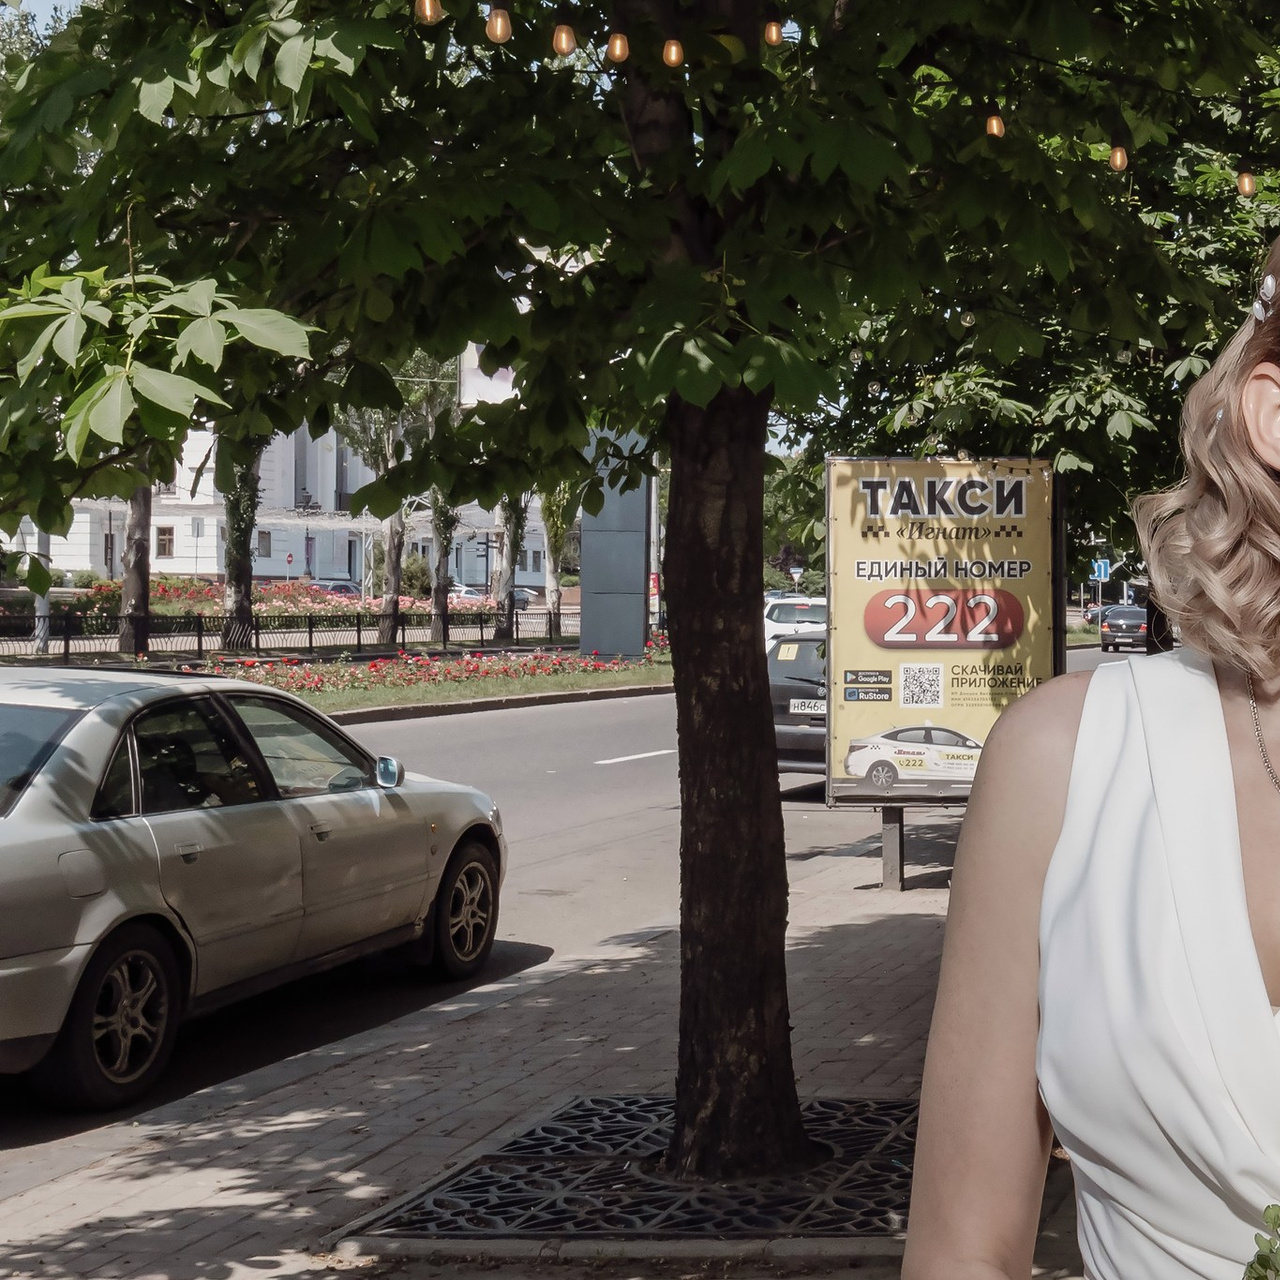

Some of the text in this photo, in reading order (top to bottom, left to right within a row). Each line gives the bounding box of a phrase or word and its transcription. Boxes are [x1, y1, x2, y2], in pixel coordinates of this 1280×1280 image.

[860, 478, 1025, 517] ТАКСИ
[896, 521, 992, 541] «Игнат»
[856, 557, 1031, 581] ЕДИНЫЙ НОМЕР
[883, 593, 1000, 642] 222
[951, 663, 1023, 676] СКАЧИВАЙ
[858, 675, 889, 683] Google Play
[951, 677, 1043, 688] ПРИЛОЖЕНИЕ
[859, 692, 890, 700] RuStore
[905, 759, 924, 767] 222
[946, 753, 974, 761] ТАКСИ
